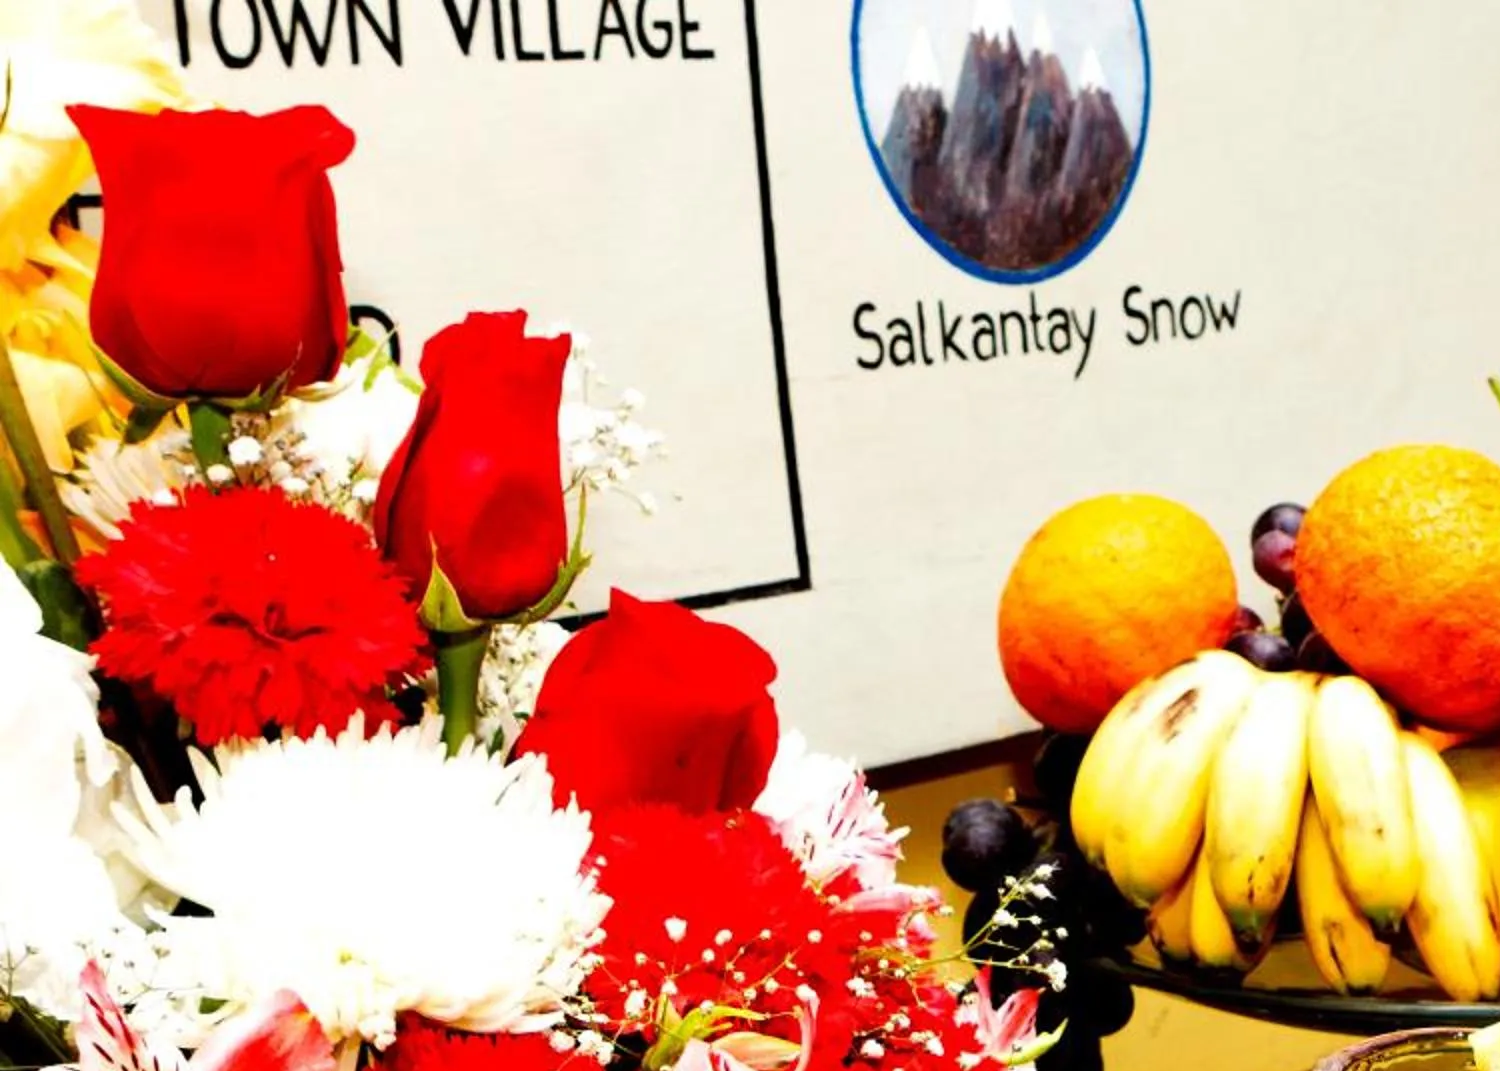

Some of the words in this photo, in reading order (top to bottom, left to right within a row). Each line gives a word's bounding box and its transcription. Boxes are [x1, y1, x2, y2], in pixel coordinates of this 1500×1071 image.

[441, 0, 716, 61] VILLAGE
[852, 292, 1096, 379] Salkantay
[1122, 285, 1241, 345] Snow
